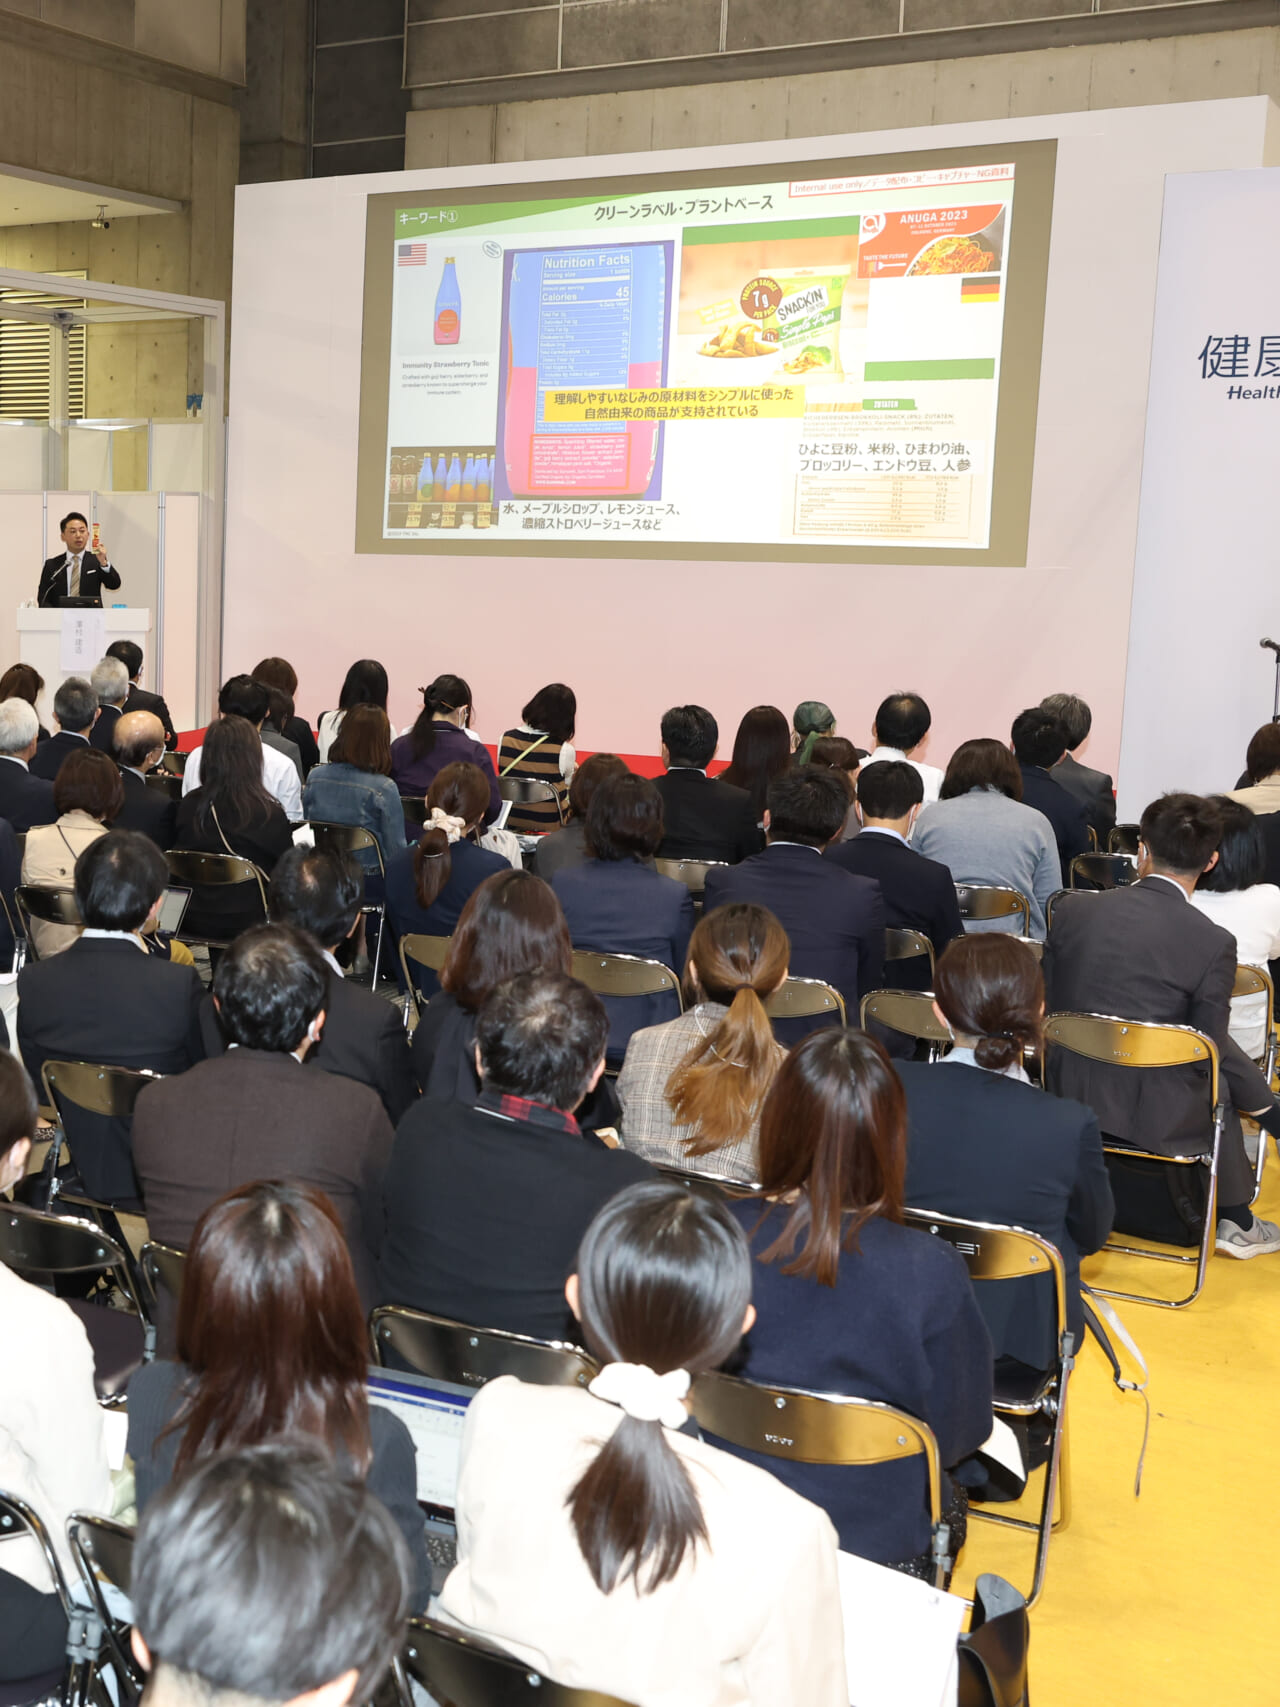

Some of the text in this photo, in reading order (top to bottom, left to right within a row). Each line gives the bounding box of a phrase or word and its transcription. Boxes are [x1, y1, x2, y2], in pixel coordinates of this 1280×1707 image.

[594, 195, 774, 221] クリーンラベル・プラントベース
[399, 210, 459, 225] キーワード①
[900, 210, 968, 224] ANUGA 2023
[544, 254, 630, 268] Nutrition Facts
[543, 286, 630, 301] Calories 45
[752, 290, 769, 308] 7g
[555, 388, 794, 405] 理解しやすいなじみの原材料をシンプルに使った
[584, 405, 758, 420] 自然由来の商品が支持されている
[798, 442, 971, 456] ひよこ豆粉、米粉、ひまわり油、
[800, 459, 971, 472] ブロッコリー、エンドウ豆、人参
[503, 502, 681, 516] 水、メープルシロップ、レモンジュース、
[522, 517, 661, 531] 濃縮ストロベリージュースなど
